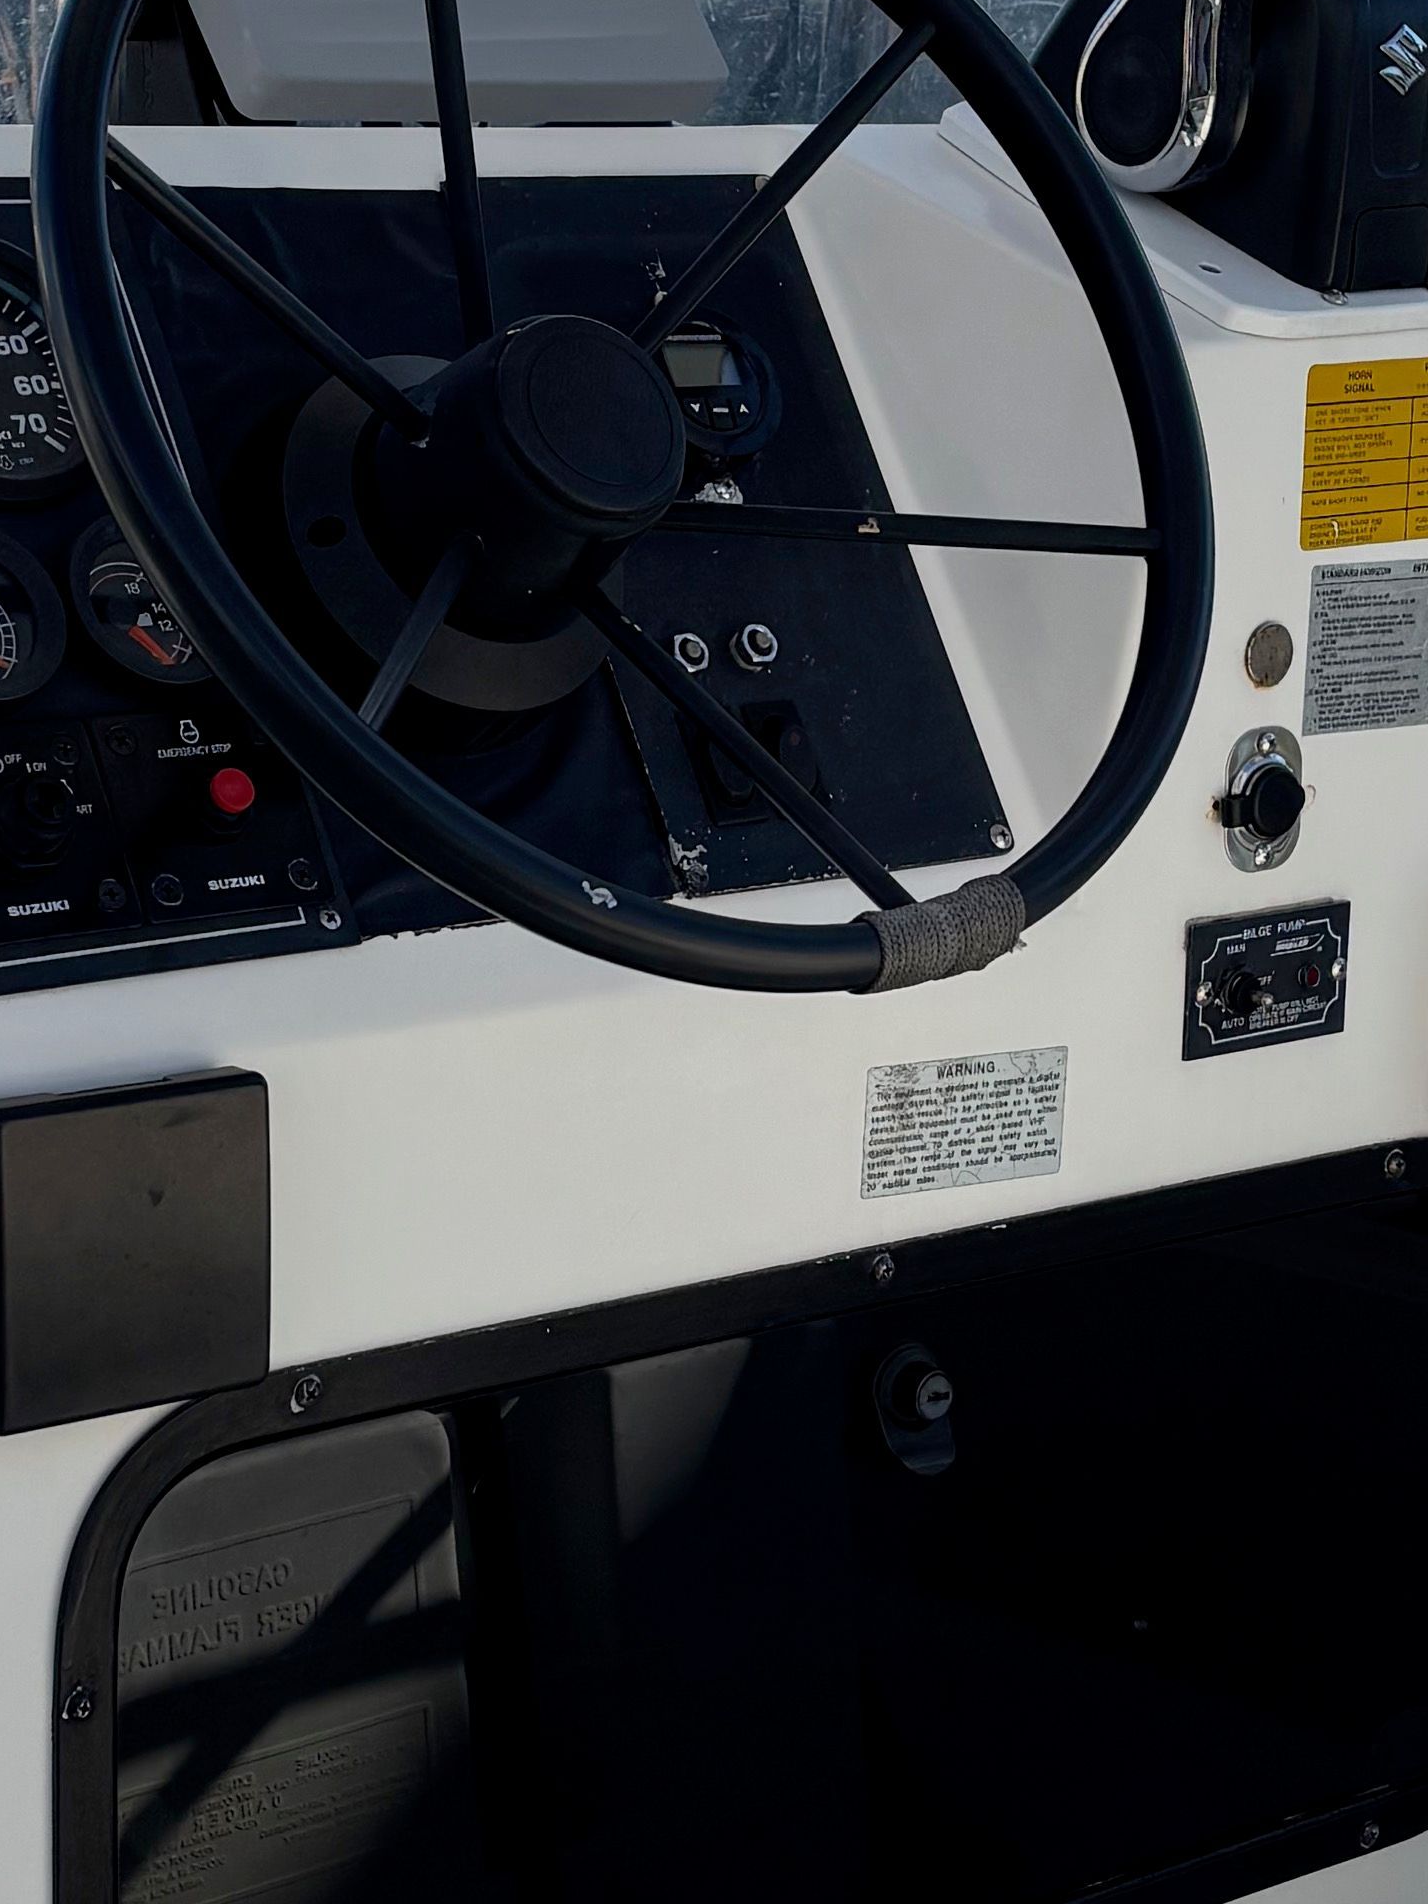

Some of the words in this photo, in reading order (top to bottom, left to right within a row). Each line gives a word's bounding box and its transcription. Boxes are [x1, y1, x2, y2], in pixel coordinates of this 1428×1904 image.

[1348, 370, 1373, 381] HORN
[13, 375, 50, 395] 60
[1344, 384, 1375, 394] SIGNAL
[10, 413, 47, 434] 70
[124, 583, 141, 595] 18
[151, 603, 167, 614] 14
[158, 619, 173, 632] 12
[211, 743, 231, 753] STOP
[4, 754, 22, 764] OFF
[33, 762, 46, 772] ON
[208, 875, 265, 891] SUZUKI
[7, 899, 70, 917] SUZUKI
[1244, 925, 1272, 939] BILGE
[1278, 919, 1306, 933] PUMP
[1221, 1017, 1245, 1029] AUTO
[936, 1059, 995, 1079] WARNING
